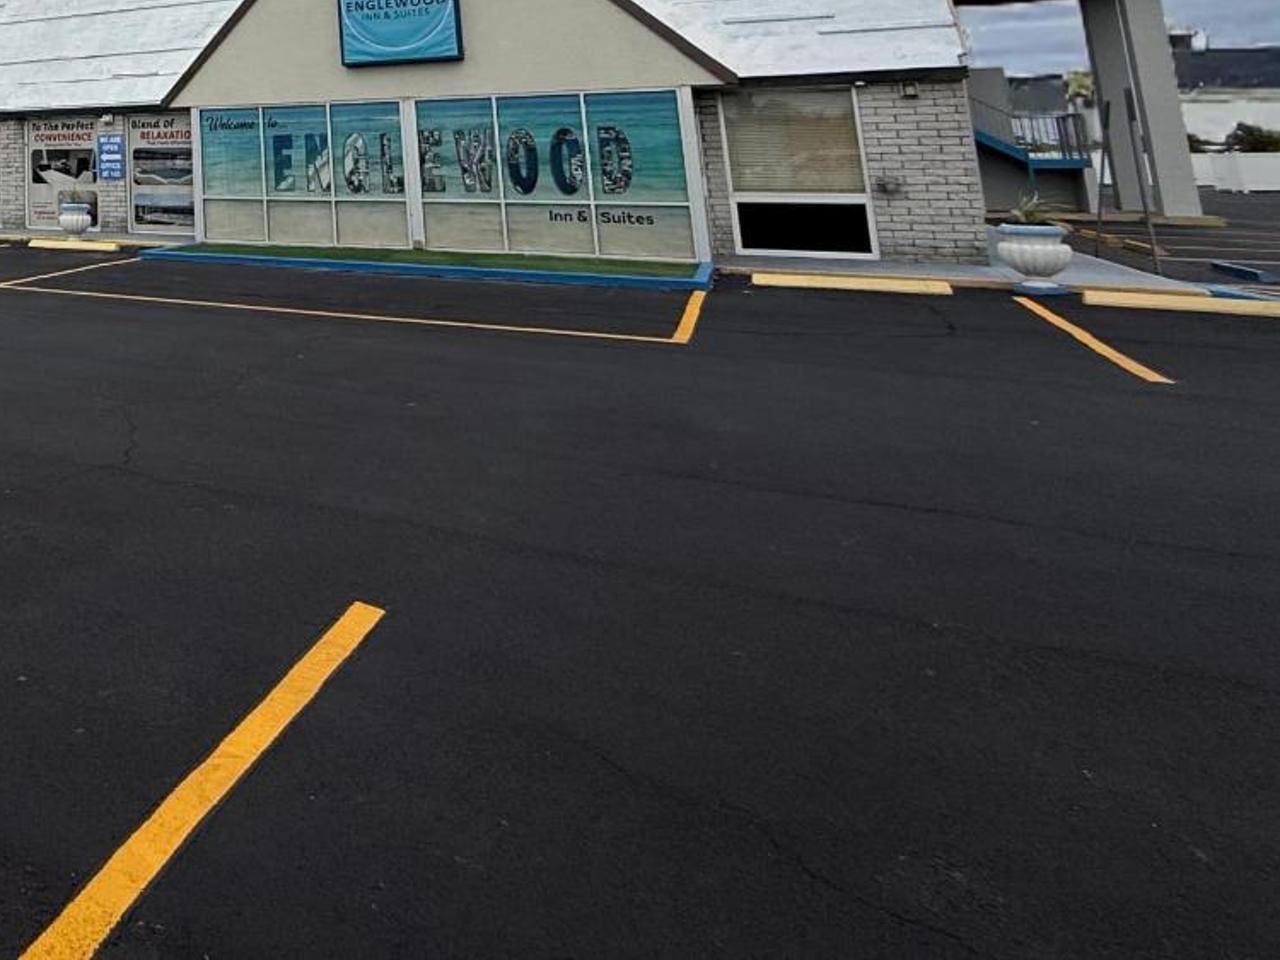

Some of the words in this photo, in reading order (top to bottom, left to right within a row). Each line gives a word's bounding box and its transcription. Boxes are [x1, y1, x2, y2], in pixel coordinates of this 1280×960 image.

[361, 12, 381, 21] INN
[383, 11, 391, 20] &
[393, 7, 431, 20] SUITES
[61, 120, 95, 131] Perfect
[131, 119, 160, 129] Blend
[205, 116, 256, 132] Welcome
[34, 132, 93, 142] CONVENIENCE
[140, 129, 192, 140] RELAXATIO
[273, 126, 634, 195] ENGLEWOOD
[548, 209, 574, 223] Inn
[576, 210, 588, 223] &
[600, 210, 655, 225] Suites
